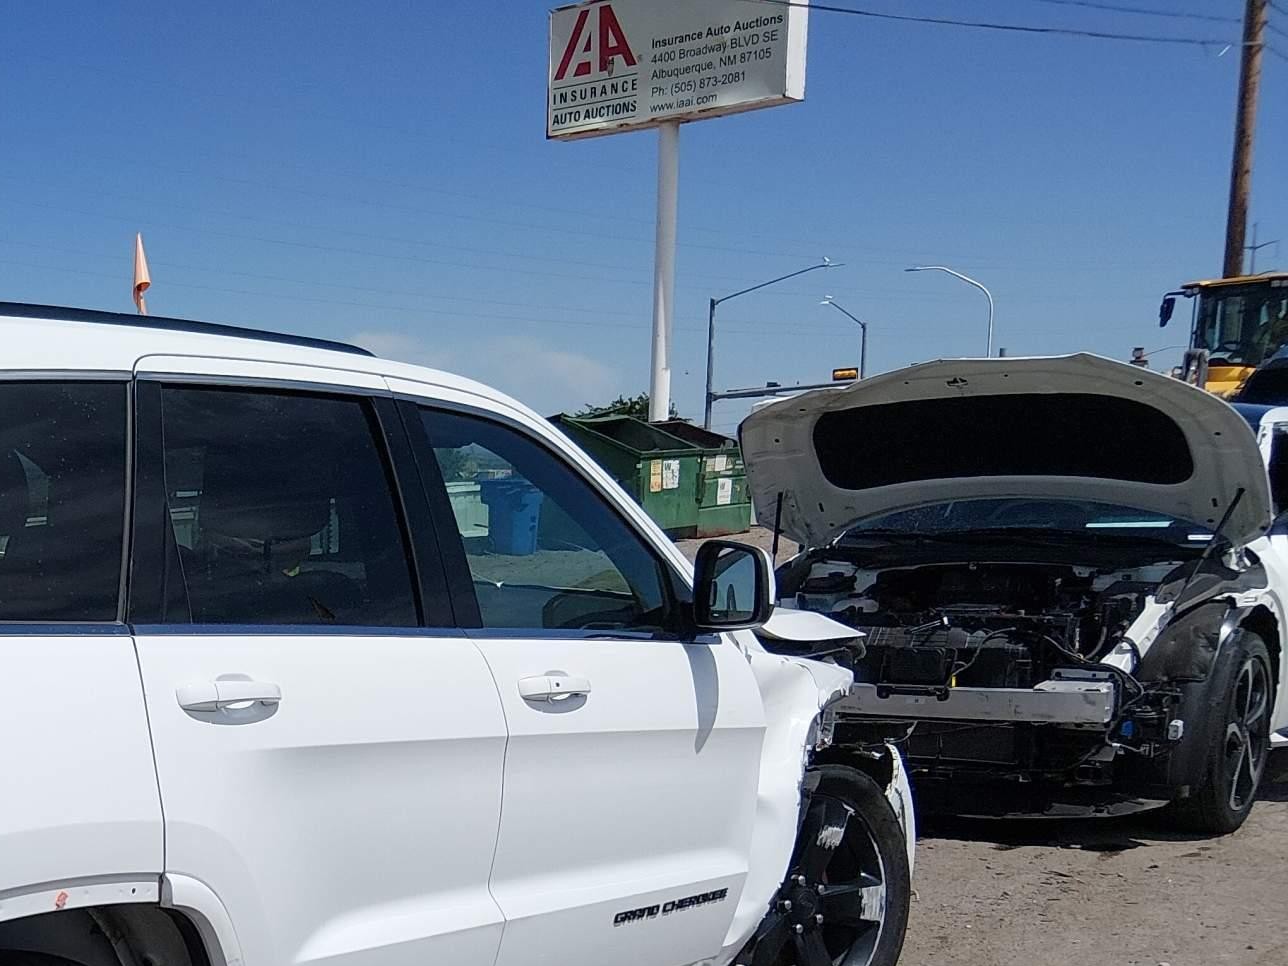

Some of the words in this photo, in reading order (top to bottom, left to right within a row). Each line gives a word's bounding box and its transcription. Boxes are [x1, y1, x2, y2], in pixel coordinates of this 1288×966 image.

[651, 31, 703, 49] Insurance
[705, 25, 731, 38] Auto
[733, 14, 784, 32] Auctions
[651, 50, 676, 65] 4400
[678, 40, 727, 60] Broadway
[730, 33, 760, 50] BLVD
[762, 29, 779, 43] SE
[719, 55, 737, 68] NM
[739, 47, 772, 64] 87105
[553, 78, 638, 106] INSURANCE
[651, 85, 668, 97] Ph:
[670, 80, 697, 97] (505)
[699, 71, 746, 89] 873-2081
[552, 110, 581, 127] AUTO
[583, 100, 637, 121] AUCTIONS
[649, 93, 717, 113] www.iaai.com
[613, 904, 660, 924] GRAND
[662, 888, 728, 914] CHEROKEE
